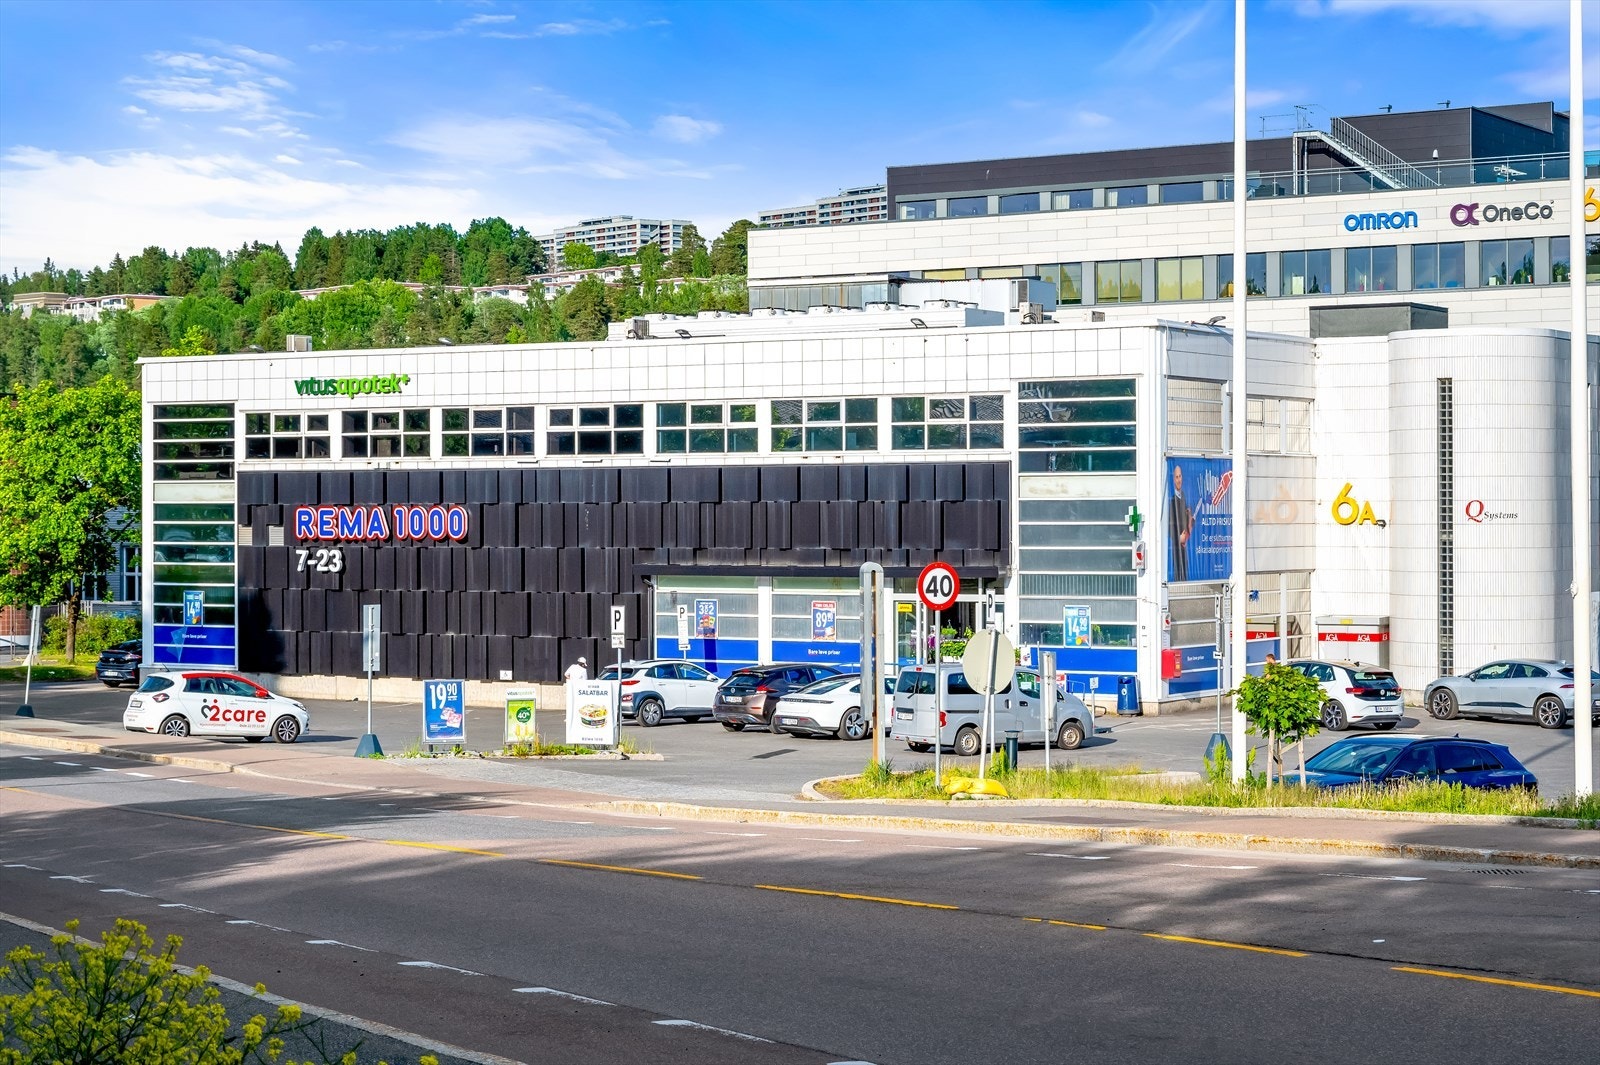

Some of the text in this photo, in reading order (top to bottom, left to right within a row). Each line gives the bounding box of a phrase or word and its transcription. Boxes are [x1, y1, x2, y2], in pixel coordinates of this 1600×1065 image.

[1482, 201, 1553, 222] OneCo
[1331, 482, 1377, 525] 6A
[295, 505, 468, 542] REMA 1000
[1484, 511, 1518, 521] Systems
[295, 549, 343, 573] 7-23
[925, 575, 953, 598] 40
[679, 607, 685, 619] P
[988, 593, 993, 618] P
[614, 609, 622, 630] P
[815, 613, 827, 628] 89
[1067, 617, 1079, 637] 14
[1325, 633, 1338, 641] AGA
[1357, 634, 1370, 642] AGA
[430, 683, 457, 710] 19 90
[578, 689, 608, 697] SALATBAR
[210, 705, 266, 723] 2care
